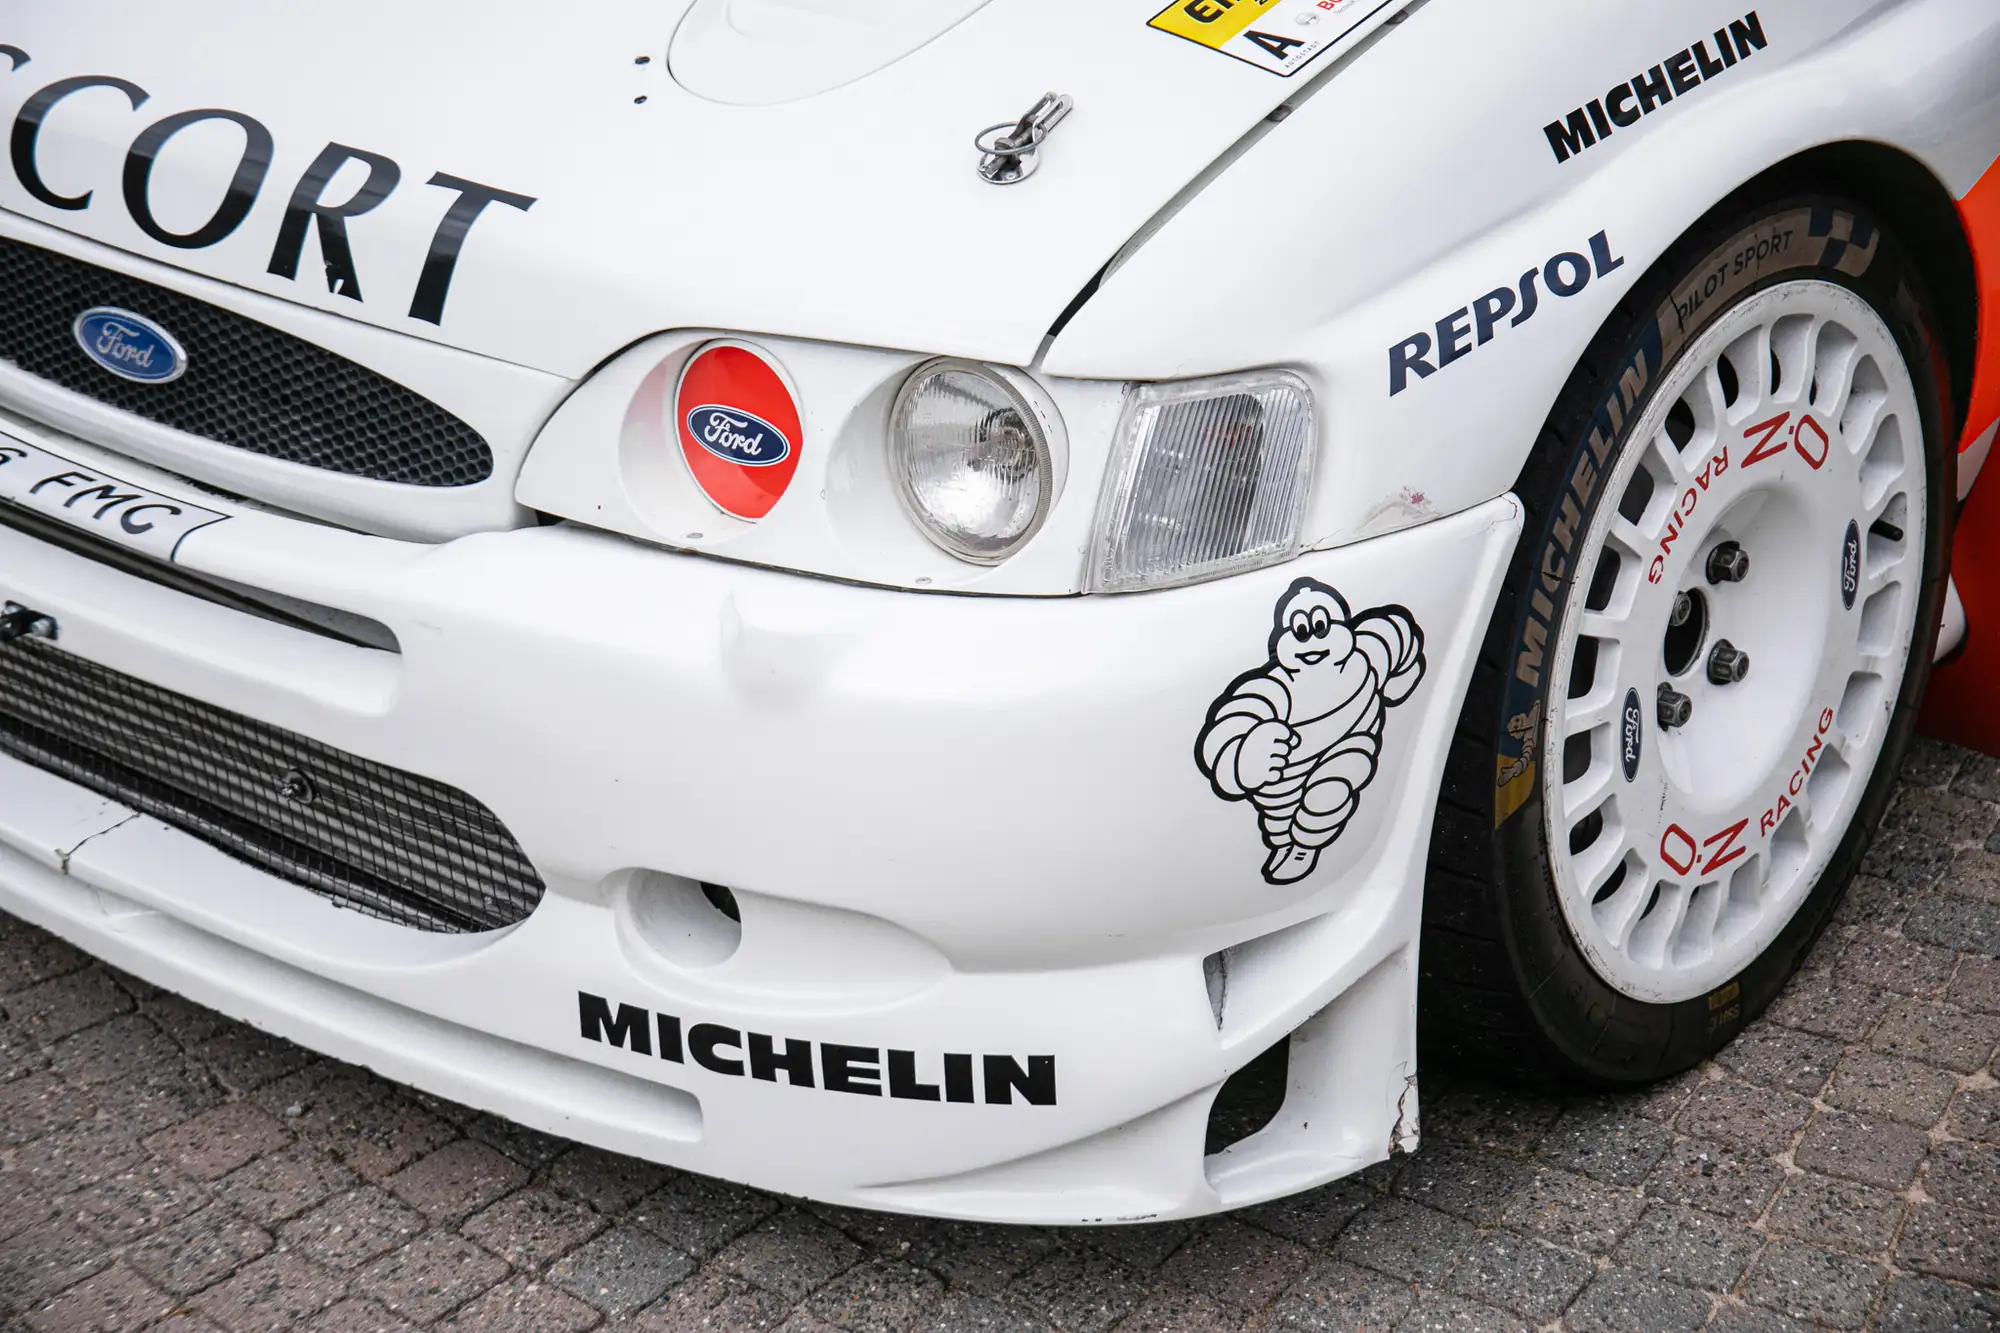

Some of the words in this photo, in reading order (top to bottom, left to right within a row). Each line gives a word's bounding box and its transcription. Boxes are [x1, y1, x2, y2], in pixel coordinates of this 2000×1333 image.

[1242, 29, 1306, 61] A
[1543, 10, 1768, 164] MICHELIN
[0, 43, 538, 327] CORT
[1388, 229, 1625, 397] REPSOL
[1678, 262, 1729, 320] PILOT
[1733, 229, 1794, 276] SPORT
[96, 320, 156, 369] Ford
[703, 411, 764, 456] Ford
[28, 470, 183, 535] FMC
[1515, 347, 1649, 689] MICHELIN
[1648, 445, 1730, 585] RACING
[1760, 706, 1834, 838] RACING
[578, 990, 1057, 1107] MICHELIN
